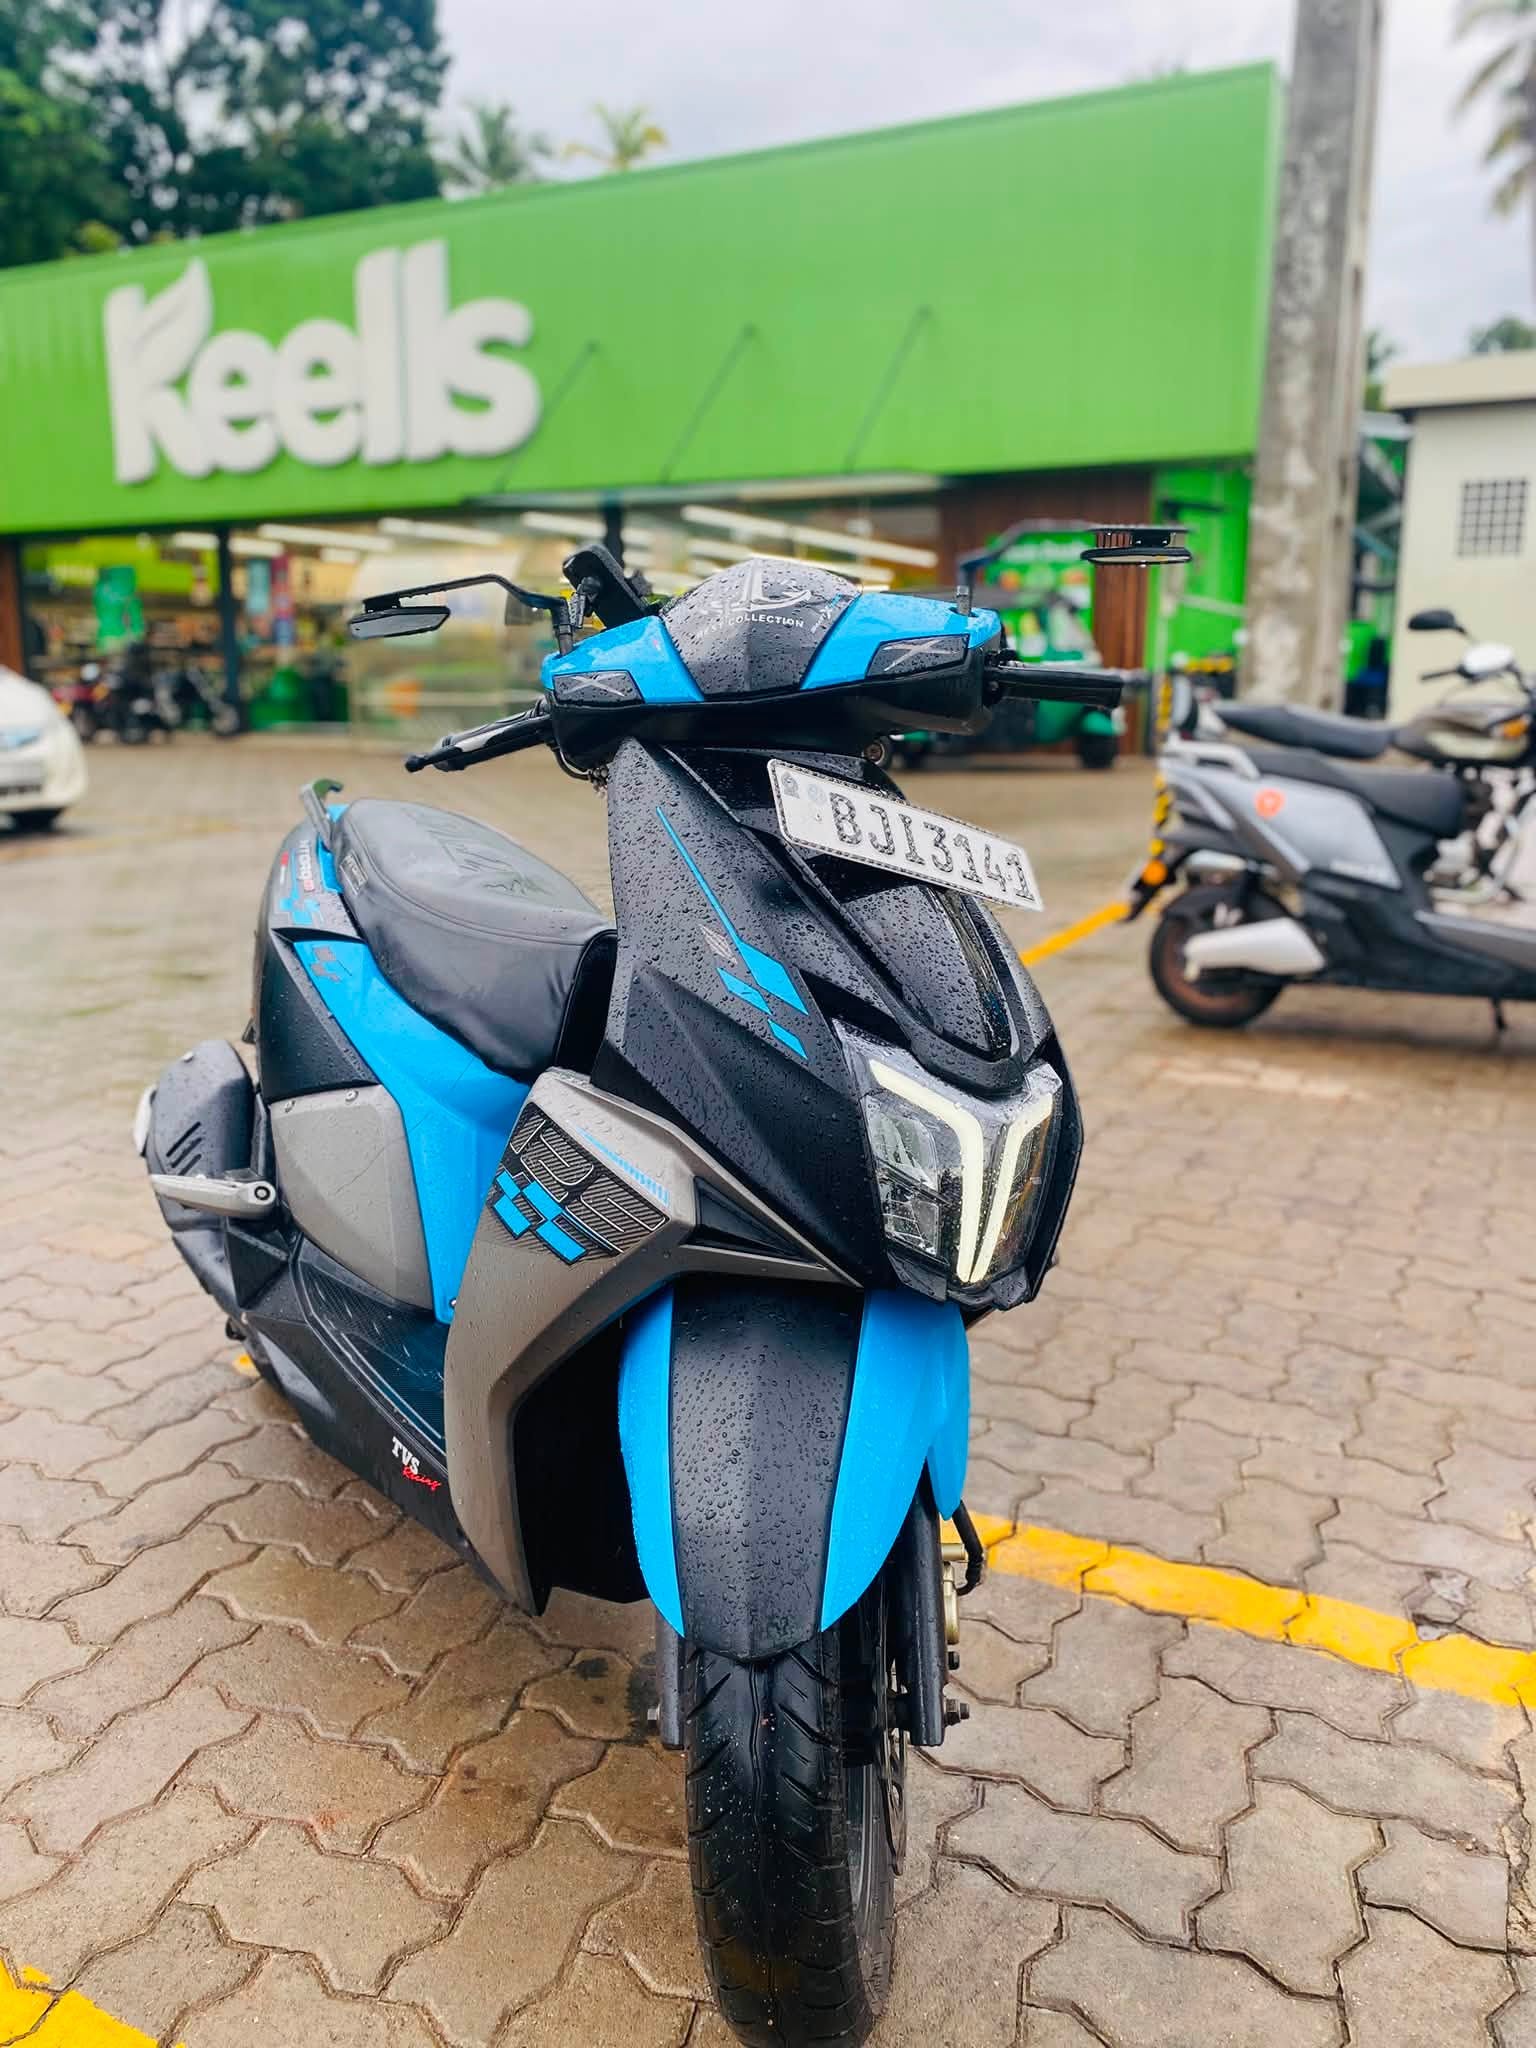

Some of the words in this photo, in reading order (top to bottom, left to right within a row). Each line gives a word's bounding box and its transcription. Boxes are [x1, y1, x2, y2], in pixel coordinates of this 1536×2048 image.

[103, 240, 541, 484] Keells
[728, 613, 805, 628] COLLECTION
[391, 1436, 420, 1475] TVS
